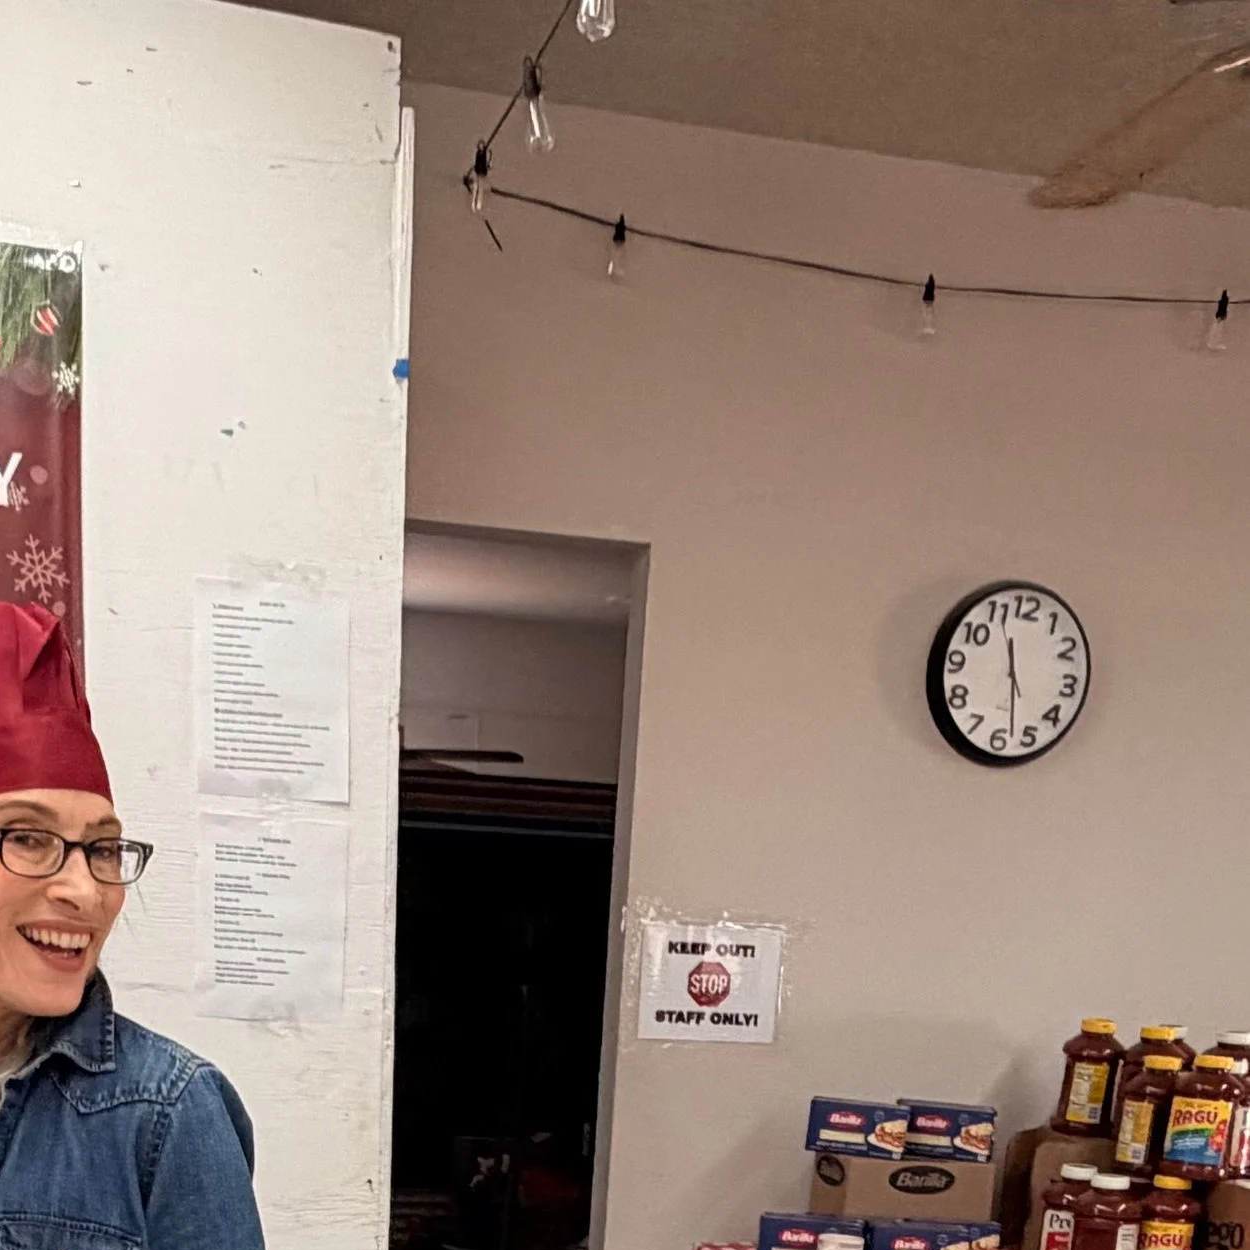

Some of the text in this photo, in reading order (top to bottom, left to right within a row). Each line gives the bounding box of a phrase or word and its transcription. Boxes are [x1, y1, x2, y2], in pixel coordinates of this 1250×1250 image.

[988, 600, 1009, 625] 11
[1014, 594, 1041, 622] 12
[963, 621, 991, 646] 10
[1049, 611, 1058, 636] 1
[947, 650, 966, 674] 9
[1057, 637, 1077, 662] 2
[948, 684, 969, 710] 8
[1059, 673, 1078, 698] 3
[967, 713, 985, 736] 7
[1041, 704, 1062, 729] 4
[989, 728, 1008, 751] 6
[1019, 725, 1039, 748] 5
[668, 941, 756, 958] KEEP OUT!
[690, 974, 728, 994] STOP
[655, 1010, 758, 1027] STAFF ONLY!
